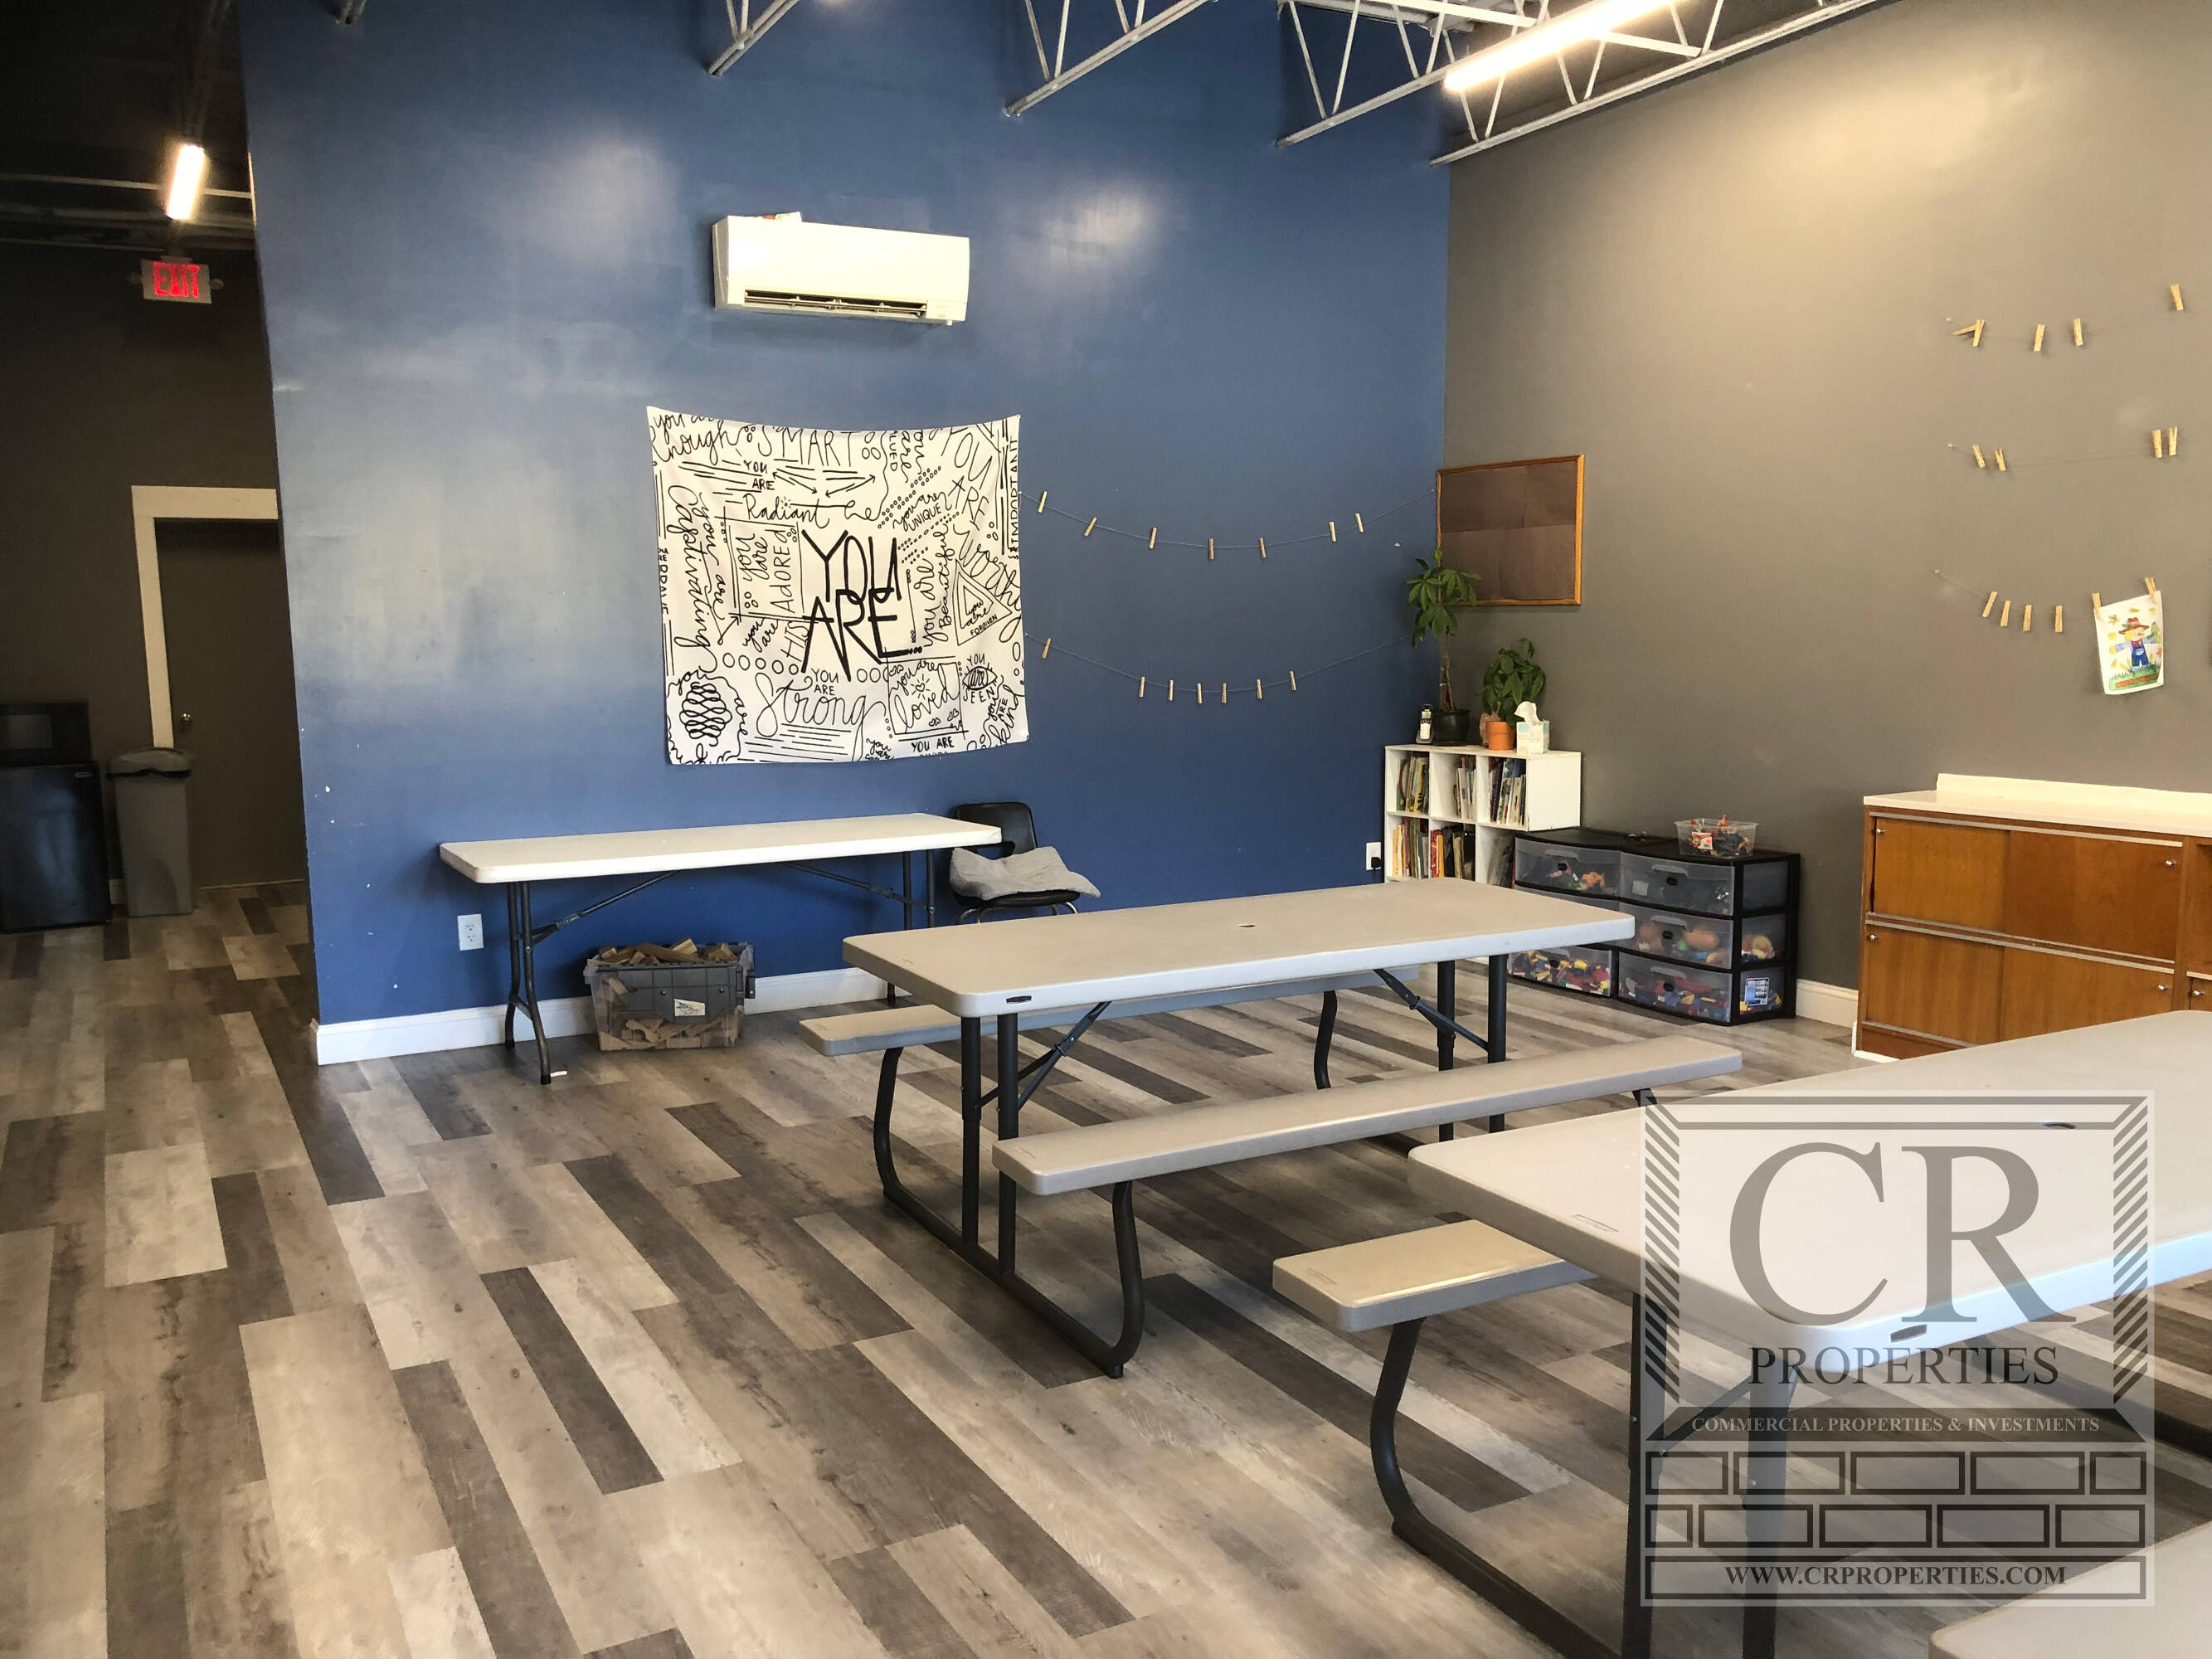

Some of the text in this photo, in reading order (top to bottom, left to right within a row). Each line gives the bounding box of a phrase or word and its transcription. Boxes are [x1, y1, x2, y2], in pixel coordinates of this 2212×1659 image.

[153, 261, 201, 299] EXIT
[744, 460, 767, 474] YOU
[751, 478, 775, 490] ARE
[908, 503, 942, 531] UNIQUE
[801, 529, 902, 603] YOU
[801, 588, 915, 682] ARE
[967, 653, 985, 665] YOU
[811, 668, 839, 684] YOU
[814, 684, 836, 696] ARE
[963, 686, 995, 704] SEEN
[911, 736, 955, 752] YOU ARE
